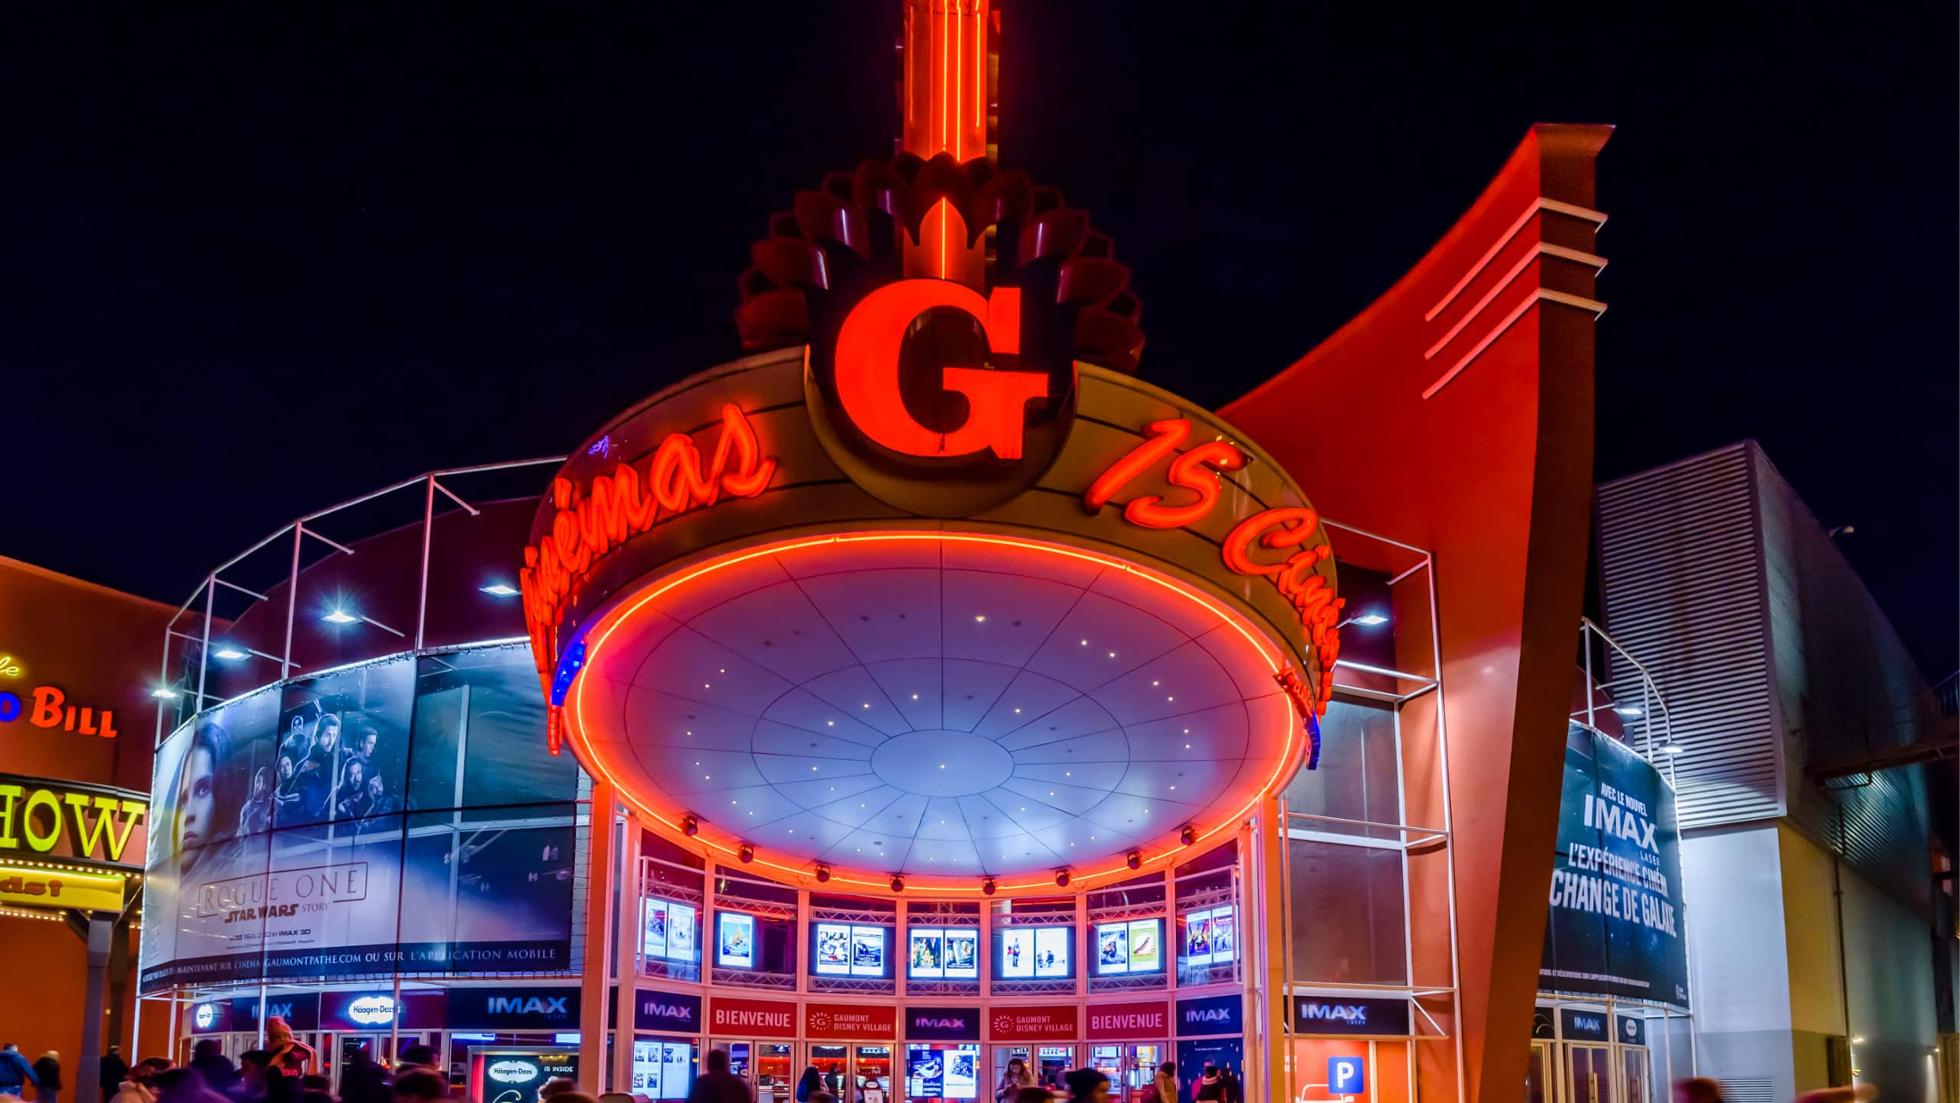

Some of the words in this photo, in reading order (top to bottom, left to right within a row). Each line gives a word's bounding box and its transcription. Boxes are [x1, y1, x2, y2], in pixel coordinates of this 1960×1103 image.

[834, 278, 1049, 459] G
[1085, 418, 1251, 529] 15
[1601, 782, 1616, 801] AVEC
[1617, 790, 1625, 806] LE
[1625, 794, 1648, 817] NOUVEL
[1584, 793, 1660, 855] IMAX
[1568, 842, 1643, 887] L'EXPÉRIENCE
[204, 878, 279, 911] ROGUE
[295, 870, 358, 899] ONE
[1549, 869, 1621, 919] CHANGE
[1622, 886, 1640, 924] DE
[224, 907, 257, 924] STAR
[258, 903, 300, 919] WARS
[365, 953, 380, 962] OU
[383, 951, 405, 961] SUR
[507, 948, 557, 960] MOBILE
[487, 997, 568, 1014] IMAX
[644, 1001, 691, 1019] IMAX
[1301, 1003, 1367, 1020] IMAX
[716, 1009, 791, 1028] BIENVENUE
[834, 1013, 869, 1023] GAUMONT
[915, 1018, 966, 1029] IMAX
[1016, 1015, 1050, 1024] GAUMONT
[1092, 1013, 1163, 1030] BIENVENUE
[1186, 1008, 1230, 1023] IMAX
[1573, 1016, 1600, 1031] IMAX
[834, 1023, 861, 1031] DISNEY
[862, 1023, 892, 1032] VILLAGE
[1016, 1024, 1042, 1032] DISNEY
[1044, 1024, 1073, 1032] VILLAGE
[1337, 1062, 1354, 1088] P
